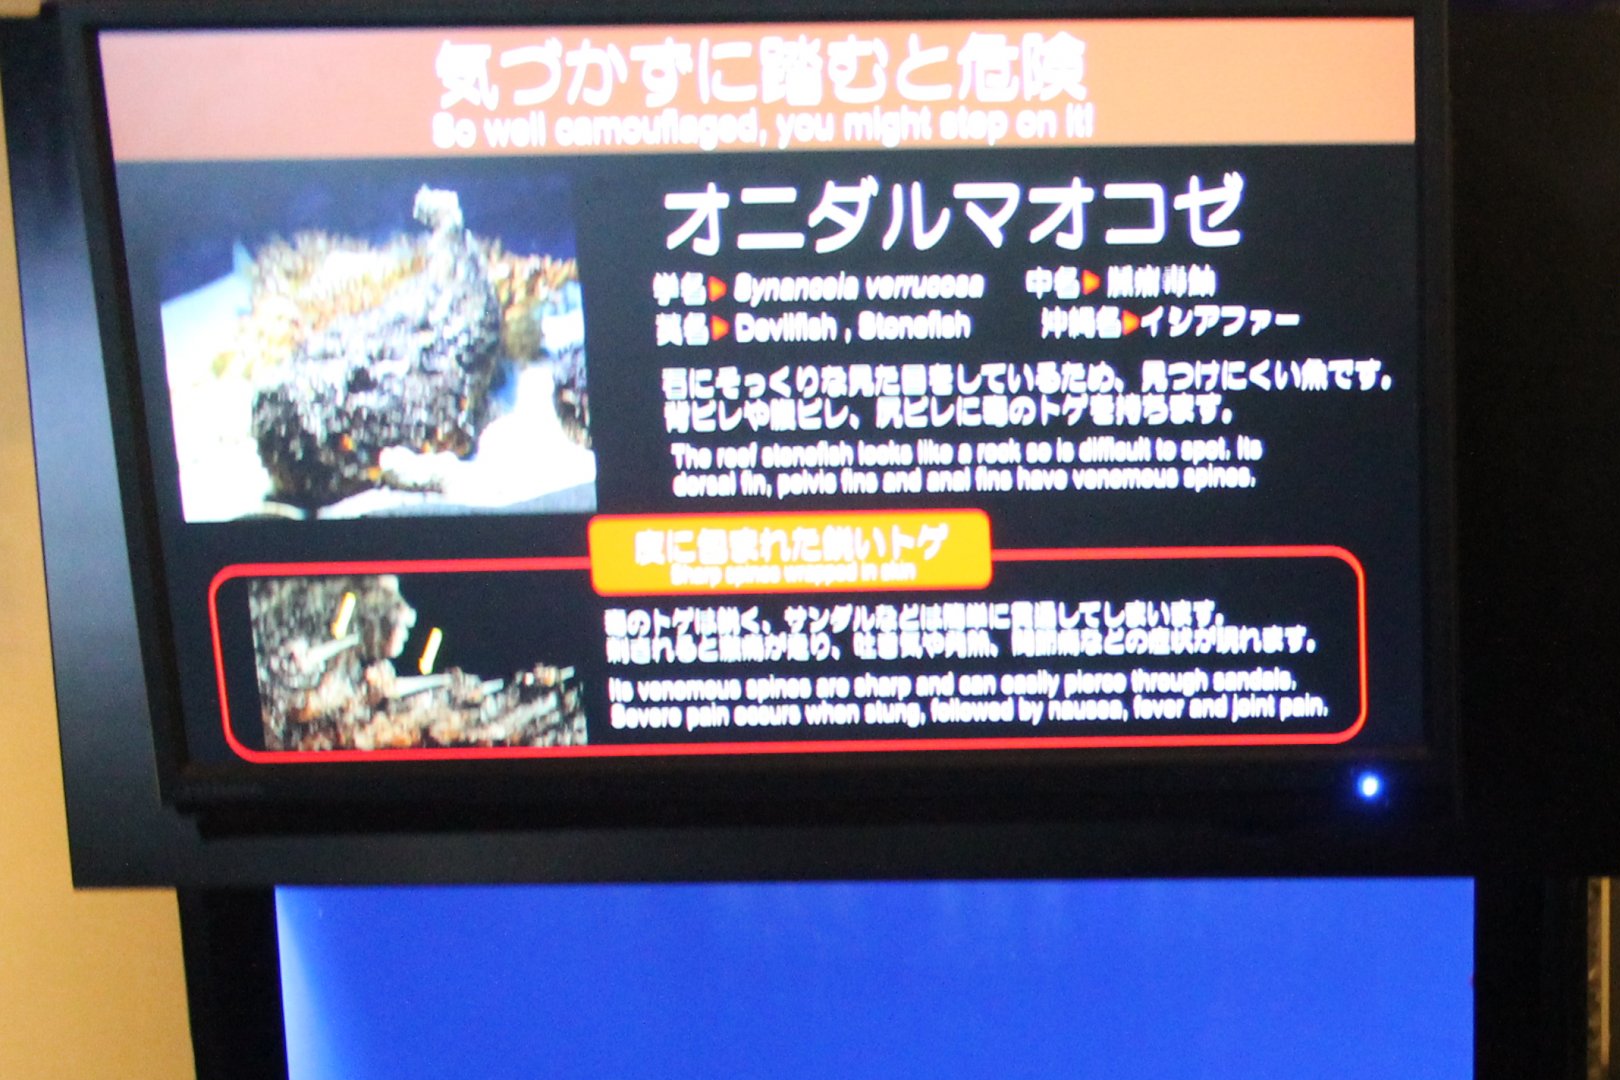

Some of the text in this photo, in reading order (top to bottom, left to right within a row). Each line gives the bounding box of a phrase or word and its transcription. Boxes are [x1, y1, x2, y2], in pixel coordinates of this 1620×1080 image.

[434, 31, 1087, 110] 気づかずに踏むと危険
[431, 101, 1097, 153] So well camouflaged, you might step on it!
[663, 172, 1245, 257] オニダルマオコゼ
[1025, 265, 1080, 299] 中名
[858, 309, 971, 340] Stonefish
[1141, 305, 1300, 338] イシアファー
[670, 442, 713, 468] The
[716, 441, 758, 468] reef
[761, 440, 855, 467] stonefish
[857, 439, 914, 465] looks
[916, 439, 954, 465] like
[957, 444, 973, 464] a
[976, 438, 1022, 464] rock
[1025, 443, 1053, 463] so
[1055, 437, 1076, 463] is
[1078, 437, 1152, 462] difficult
[1154, 436, 1178, 461] to
[1236, 435, 1263, 460] Its
[672, 470, 737, 497] dorsal
[739, 470, 773, 499] fin,
[776, 469, 838, 500] pelvic
[840, 468, 879, 494] fins
[882, 468, 923, 494] and
[926, 467, 972, 493] anal
[974, 467, 1014, 492] fins
[1016, 466, 1069, 492] have
[1071, 470, 1180, 490] venomous
[608, 677, 635, 701] Its
[637, 681, 742, 700] venomous
[745, 675, 813, 703] spines
[815, 679, 851, 698] are
[853, 673, 913, 702] sharp
[915, 672, 955, 696] and
[958, 677, 997, 696] can
[1000, 671, 1061, 700] easily
[1063, 670, 1128, 699] pierce
[1130, 669, 1209, 698] through
[610, 703, 683, 728] Severe
[685, 703, 731, 732] pain
[733, 707, 802, 726] occurs
[804, 701, 861, 725] when
[863, 700, 927, 729] stung,
[929, 698, 1015, 723] followed
[1017, 698, 1045, 727] by
[1047, 702, 1129, 724] nausea,
[1132, 696, 1189, 720] fever
[1186, 695, 1229, 719] and
[1231, 694, 1276, 724] joint
